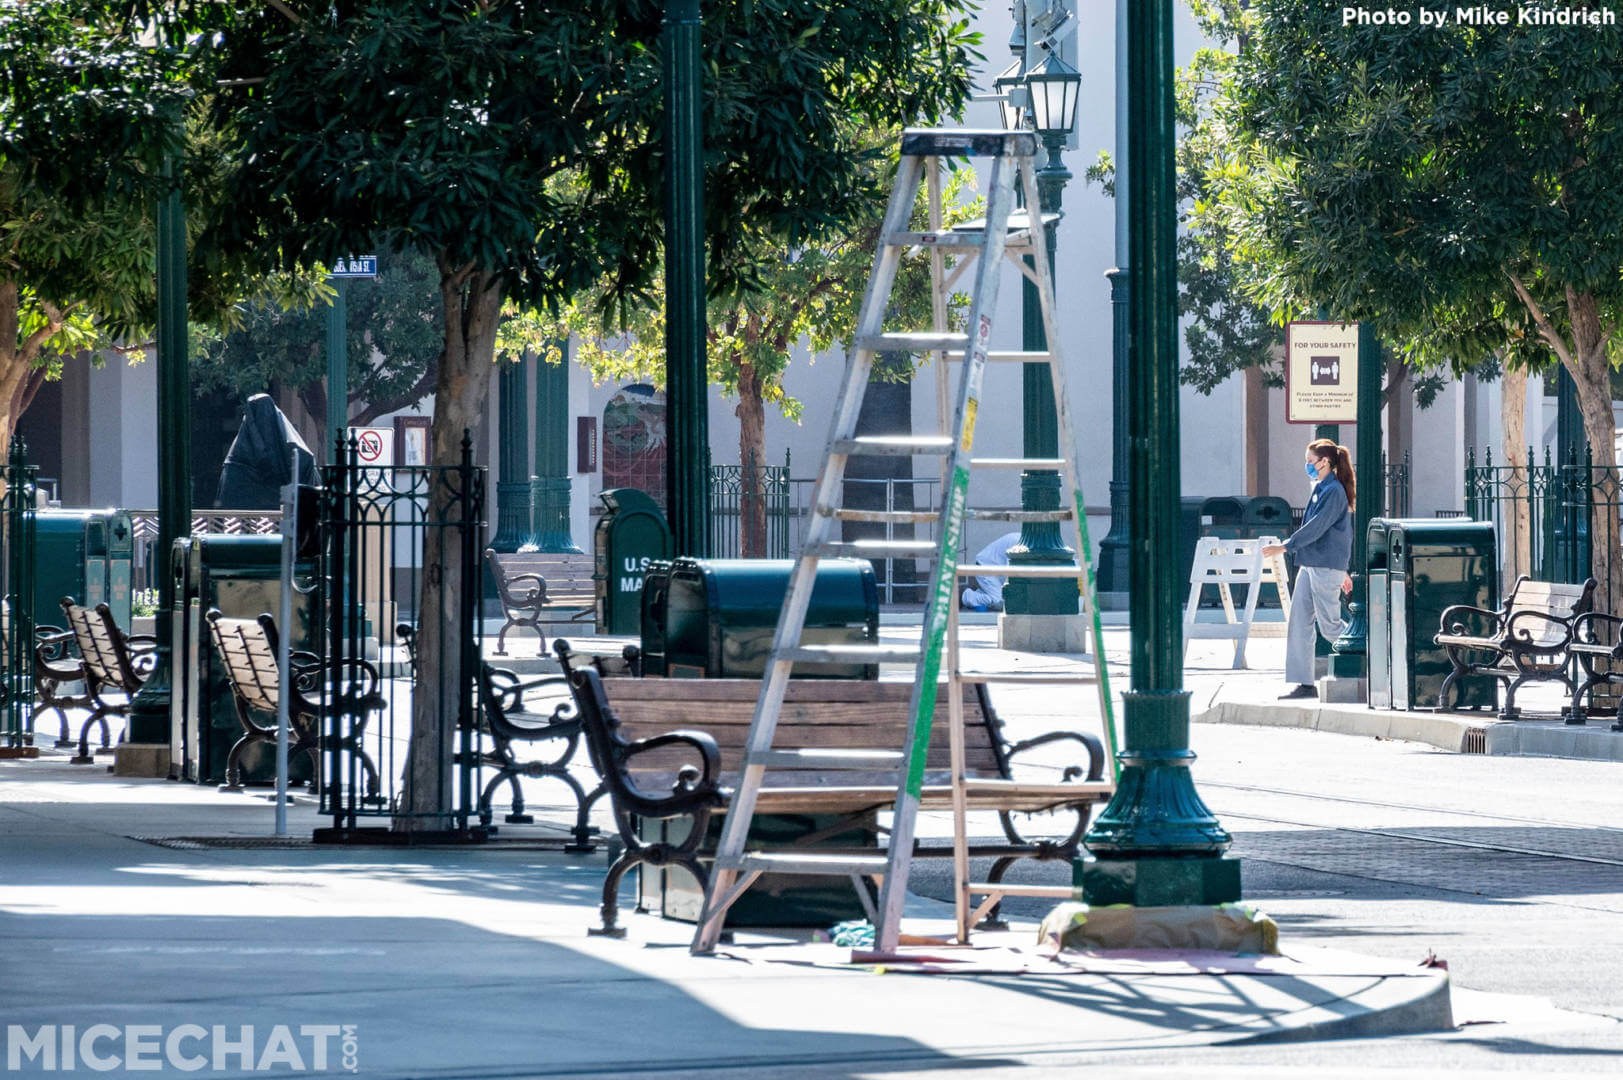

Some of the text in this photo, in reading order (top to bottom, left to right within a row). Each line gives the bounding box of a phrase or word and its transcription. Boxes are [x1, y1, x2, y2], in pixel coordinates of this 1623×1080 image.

[937, 486, 965, 621] PAINT SHOP
[624, 557, 651, 572] U.S
[620, 577, 643, 592] MA
